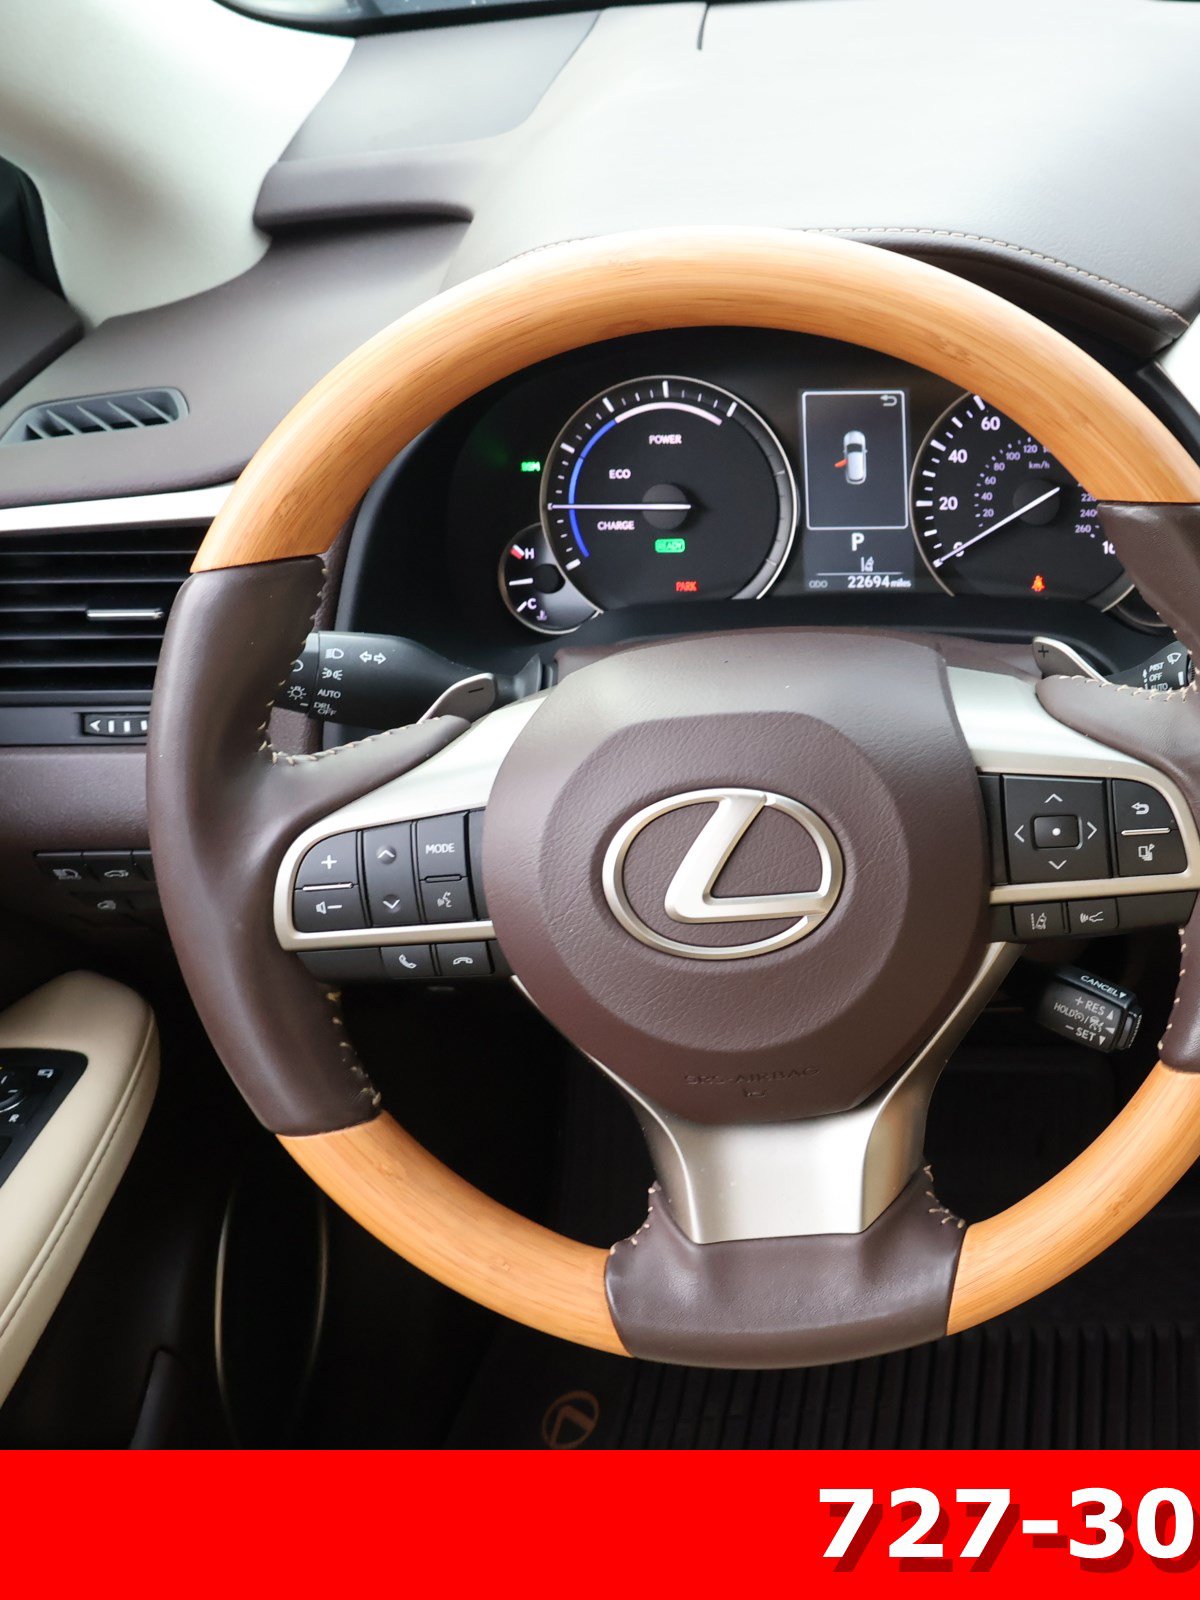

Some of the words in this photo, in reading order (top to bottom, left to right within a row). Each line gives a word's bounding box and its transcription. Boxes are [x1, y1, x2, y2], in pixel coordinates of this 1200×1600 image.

[981, 416, 1000, 430] 60
[649, 434, 682, 445] POWER
[1023, 445, 1037, 453] 120
[948, 449, 968, 463] 40
[1006, 452, 1020, 460] 100
[993, 463, 1005, 471] 80
[1029, 461, 1050, 469] km/h
[609, 469, 631, 479] ECO
[984, 477, 996, 485] 60
[981, 492, 993, 500] 40
[939, 496, 958, 510] 20
[983, 509, 994, 517] 20
[1080, 509, 1096, 517] 240
[597, 520, 635, 531] CHARGE
[1075, 525, 1091, 533] 260
[851, 532, 865, 552] P
[524, 548, 535, 560] H
[675, 581, 698, 592] PARK
[808, 580, 828, 589] ODO
[847, 575, 890, 588] 22694
[890, 579, 911, 588] miles
[527, 598, 537, 610] C
[1149, 672, 1163, 682] OFF
[317, 688, 342, 699] AUTO
[425, 843, 455, 854] MODE
[1080, 975, 1119, 997] CANCEL
[1053, 1002, 1075, 1018] HOLD
[1075, 1026, 1097, 1042] SET
[8, 1113, 20, 1123] R
